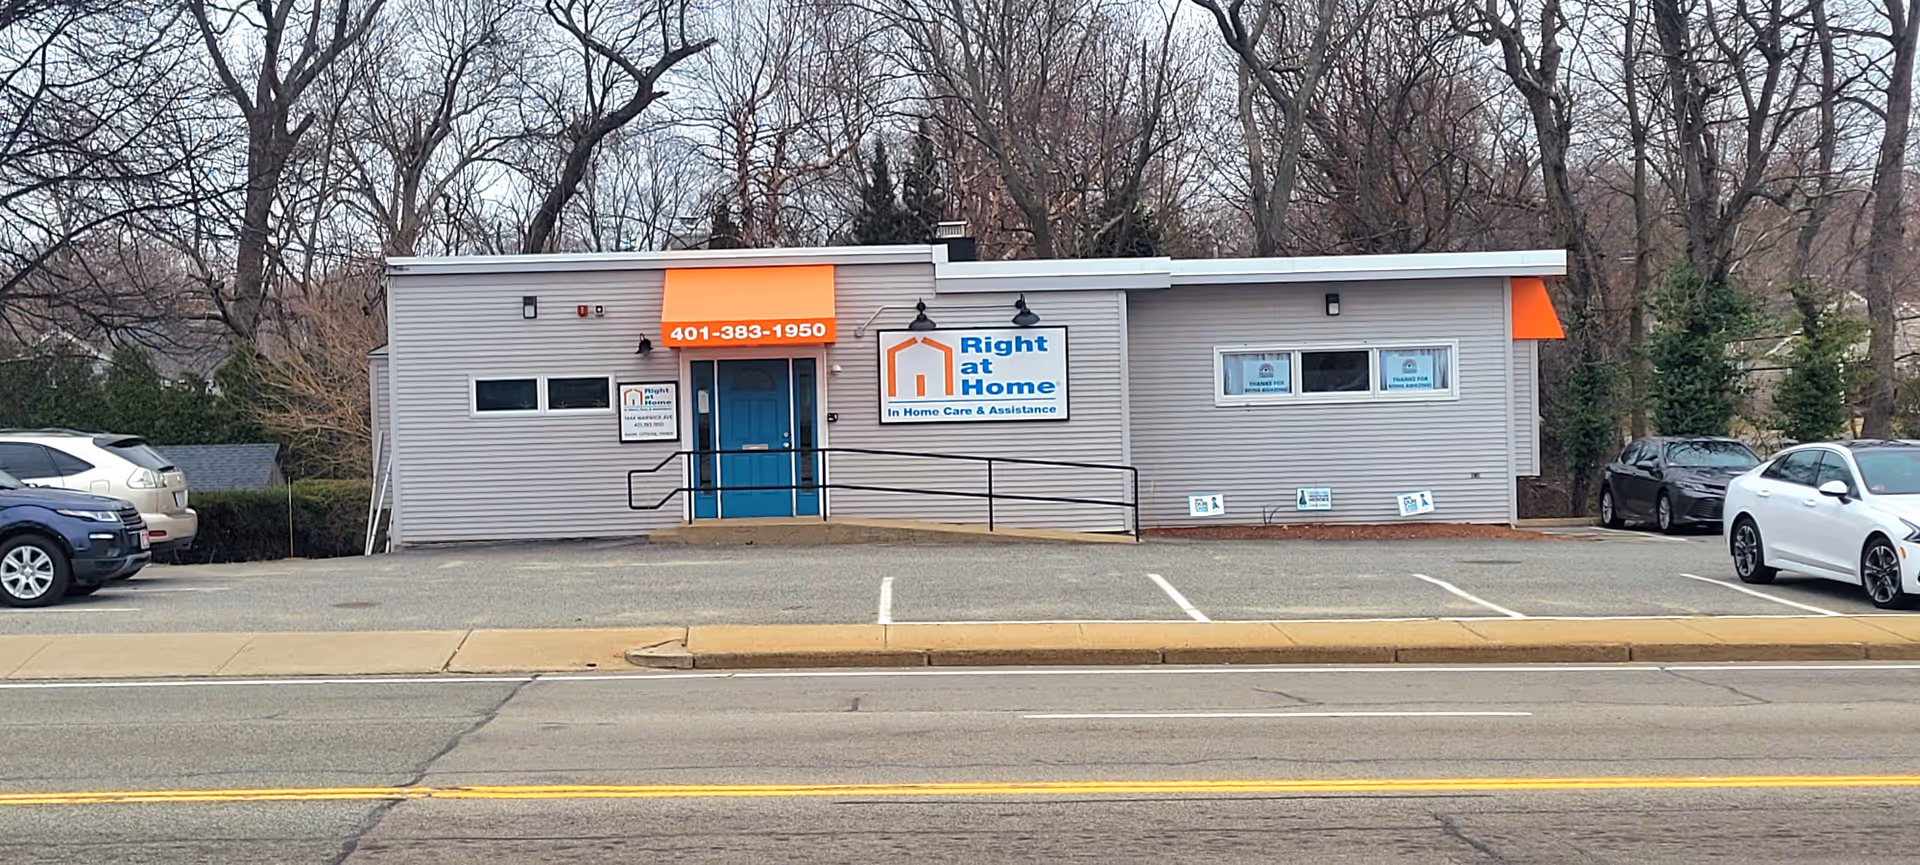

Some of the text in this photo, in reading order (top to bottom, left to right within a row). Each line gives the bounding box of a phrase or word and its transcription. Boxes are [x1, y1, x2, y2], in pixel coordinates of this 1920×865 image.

[670, 323, 826, 341] 401-383-1950
[960, 335, 1048, 356] Right
[960, 358, 993, 375] at
[961, 379, 1056, 396] Home
[888, 405, 1057, 417] In Home Care & Assistance
